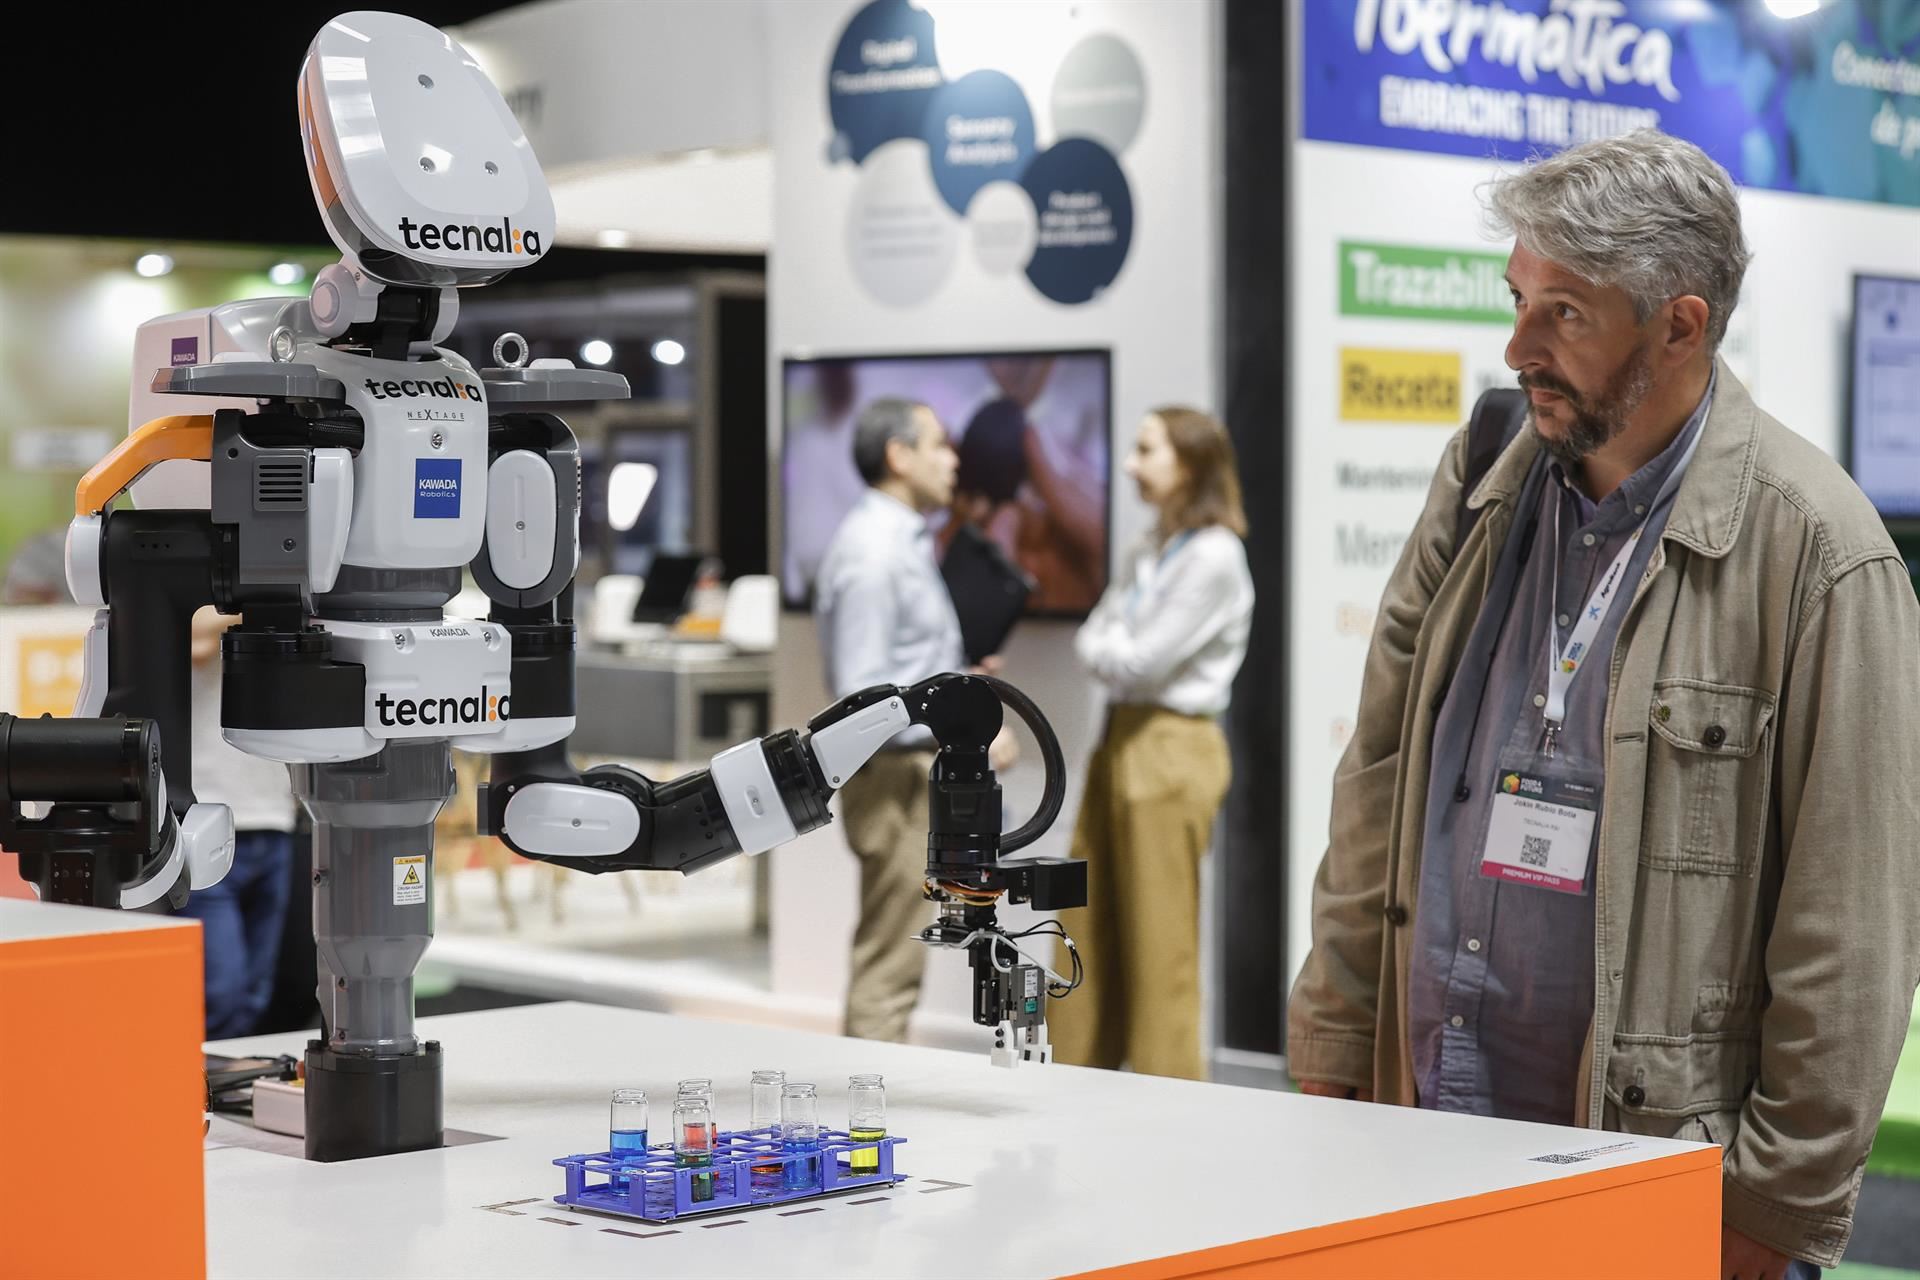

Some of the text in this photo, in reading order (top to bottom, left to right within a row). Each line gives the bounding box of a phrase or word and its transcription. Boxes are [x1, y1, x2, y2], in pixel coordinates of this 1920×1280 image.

[1526, 93, 1570, 145] THE
[407, 409, 464, 421] NEXTAGE
[419, 478, 457, 490] KAWADA
[420, 490, 456, 498] Robotics
[429, 628, 470, 637] KAWADA
